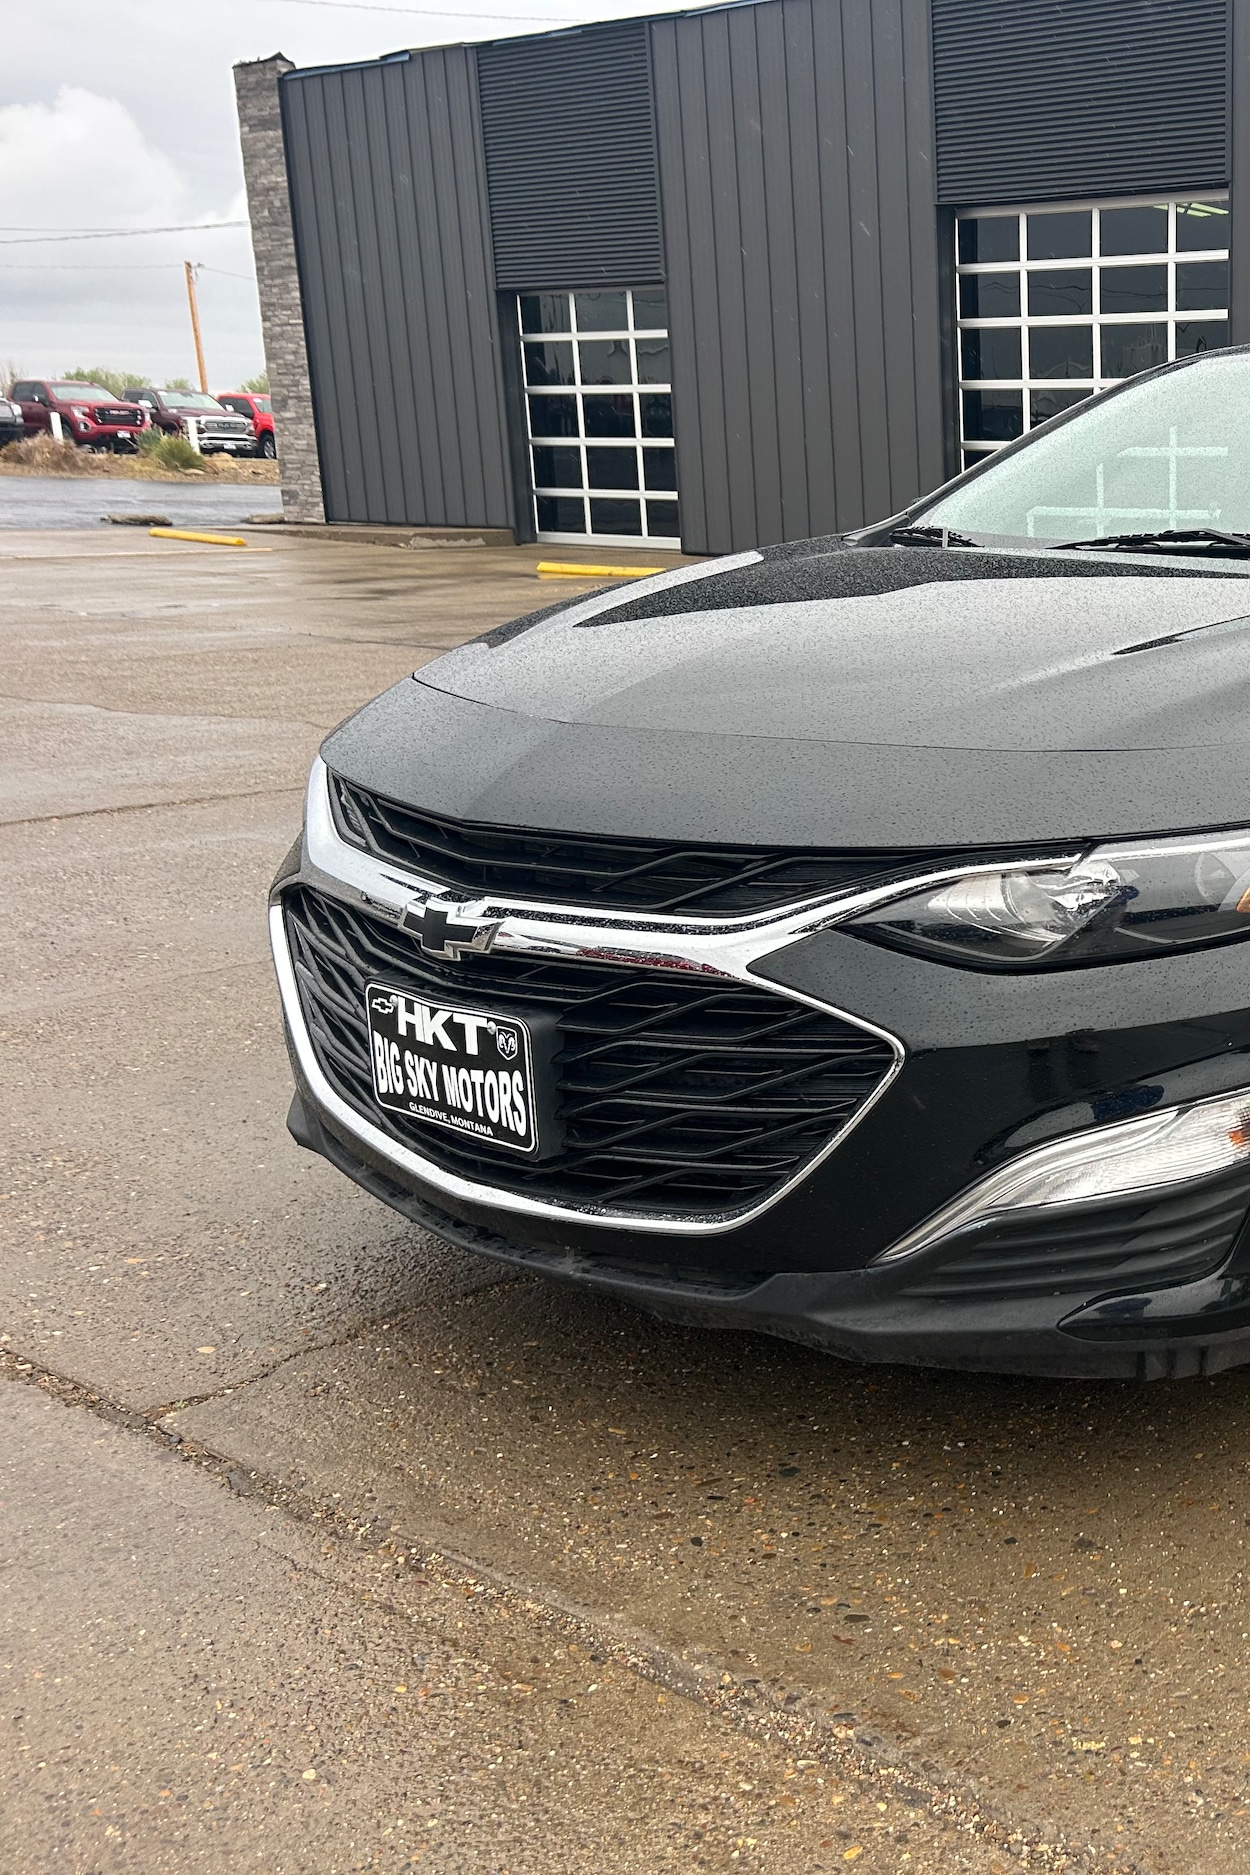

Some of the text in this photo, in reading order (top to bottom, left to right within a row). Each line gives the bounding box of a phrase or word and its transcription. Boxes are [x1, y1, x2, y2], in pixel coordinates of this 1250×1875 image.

[397, 996, 488, 1056] HKT
[373, 1030, 527, 1137] BIG SKY MOTORS
[409, 1101, 493, 1136] GLENDIVE, MONTANA
